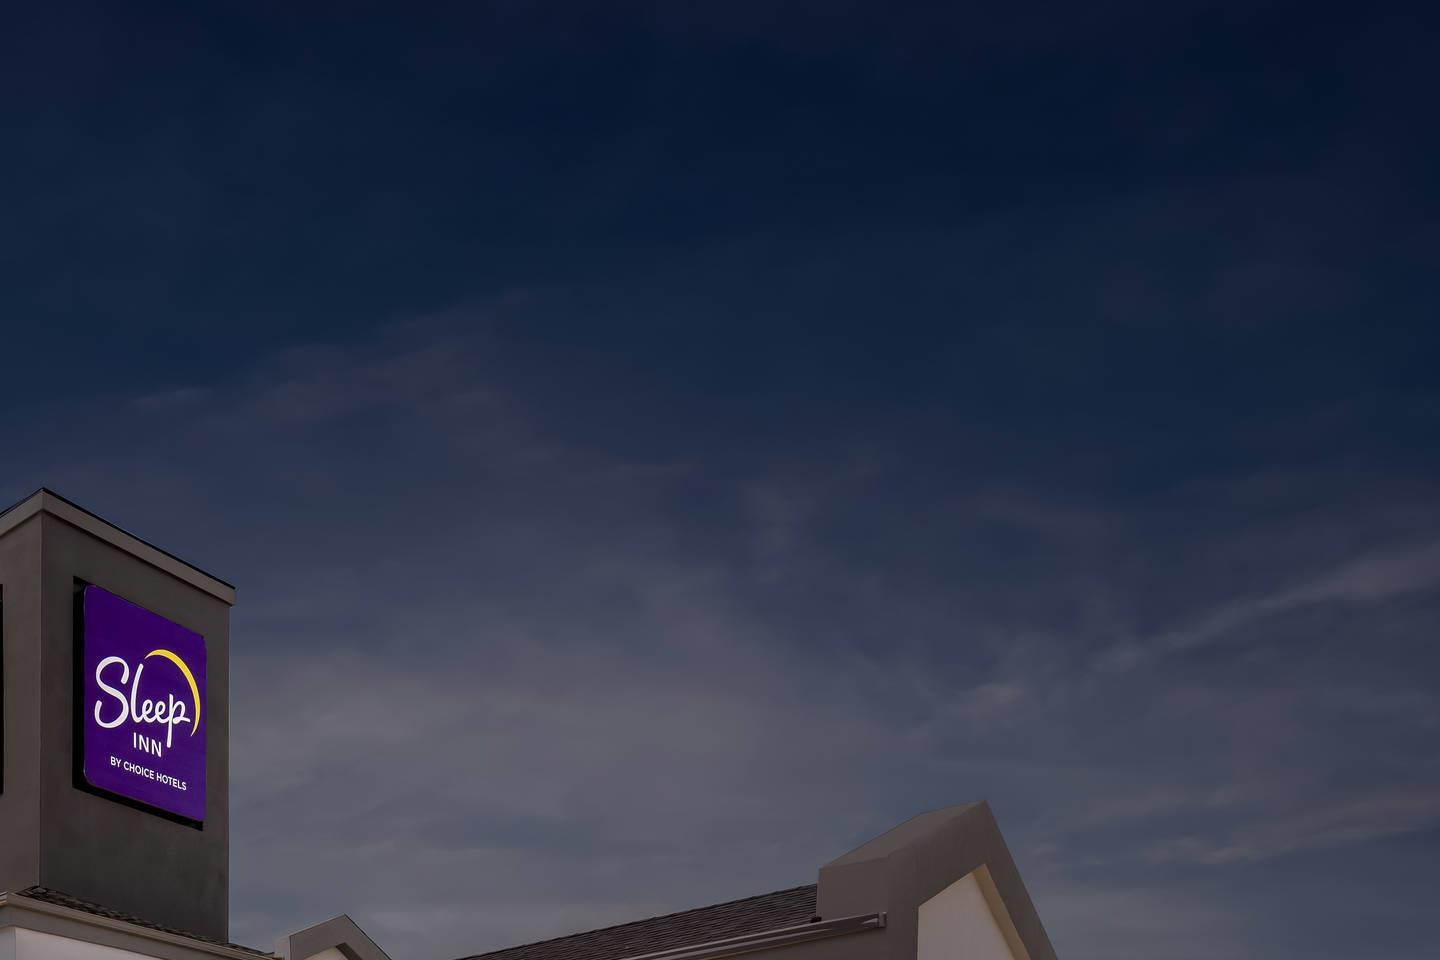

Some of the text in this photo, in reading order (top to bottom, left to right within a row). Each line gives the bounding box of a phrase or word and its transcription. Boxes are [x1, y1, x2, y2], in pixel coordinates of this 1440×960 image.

[94, 656, 191, 748] Sleep
[133, 732, 162, 758] INN
[110, 755, 187, 791] BY CHOICE HOTELS
